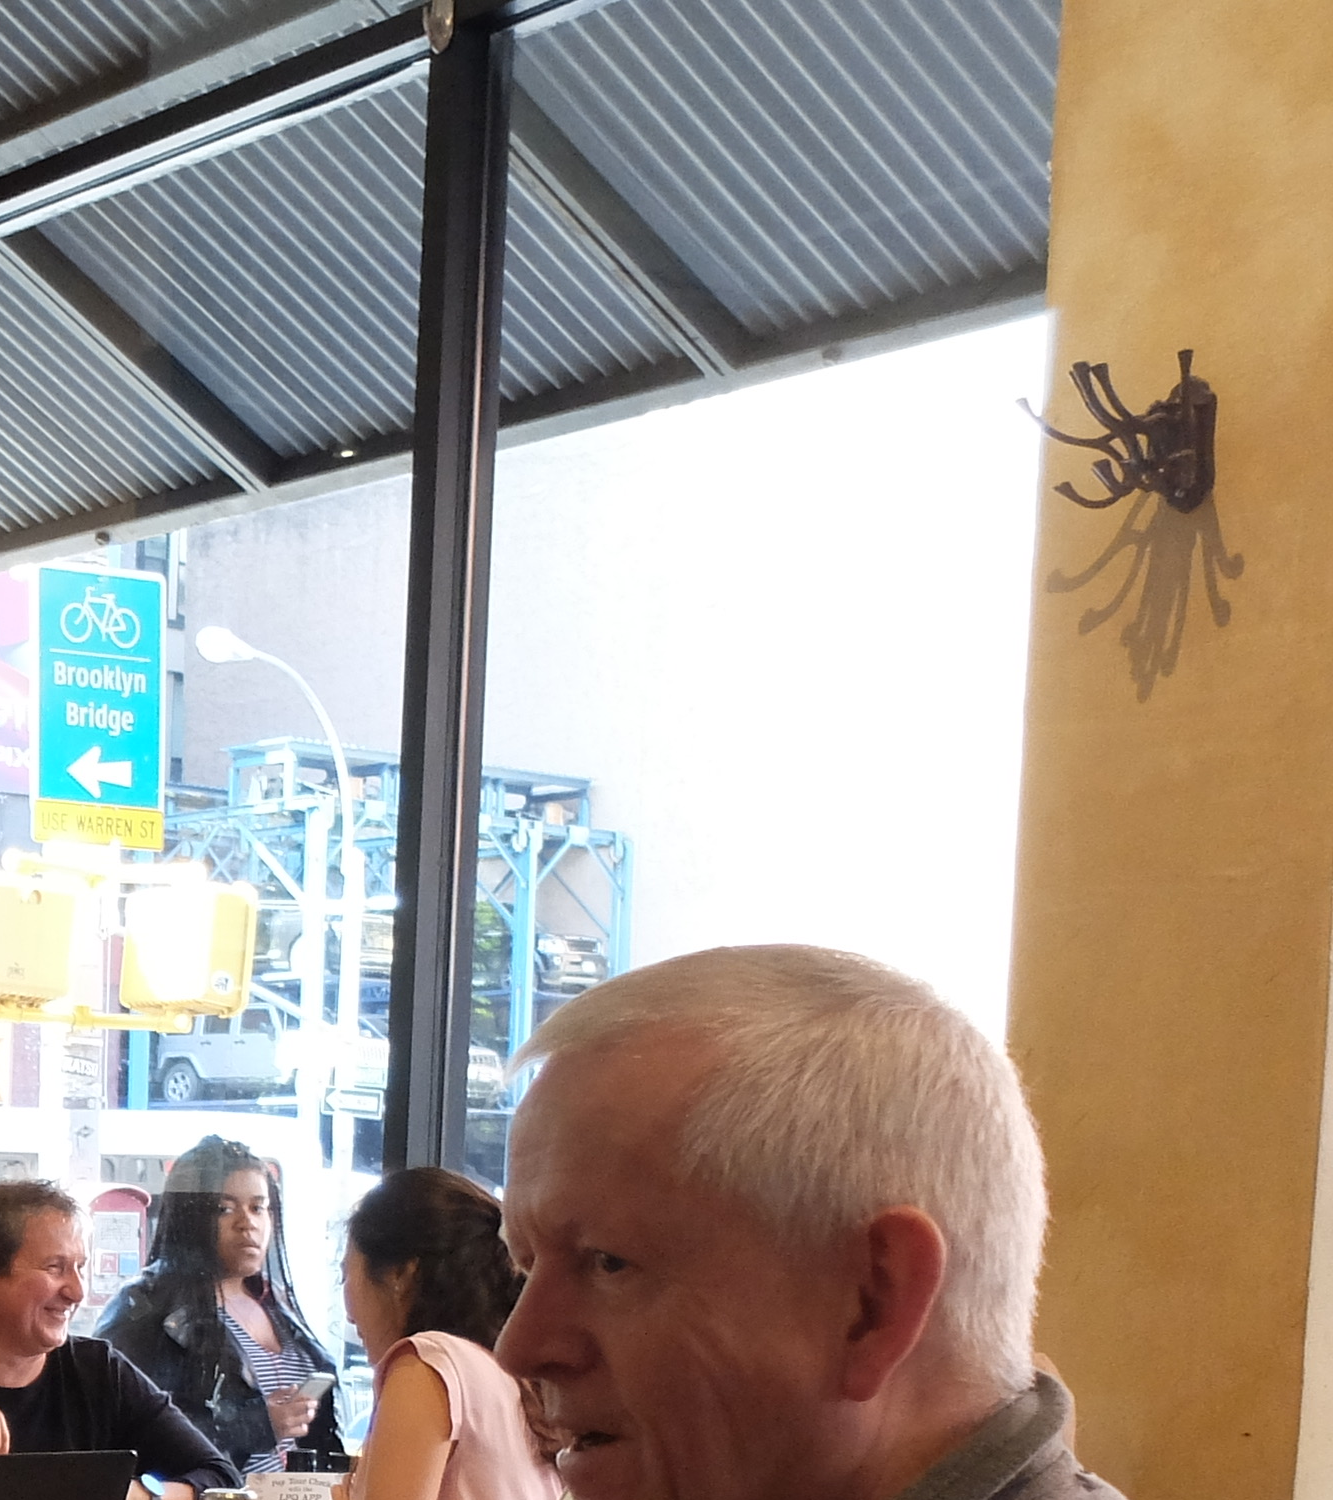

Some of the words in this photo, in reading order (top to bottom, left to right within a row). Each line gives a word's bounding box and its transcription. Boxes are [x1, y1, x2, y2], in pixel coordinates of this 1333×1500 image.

[53, 660, 148, 699] Brooklyn
[65, 701, 135, 738] Bridge
[41, 811, 69, 832] USE
[76, 814, 134, 838] WARREN
[139, 820, 156, 840] ST
